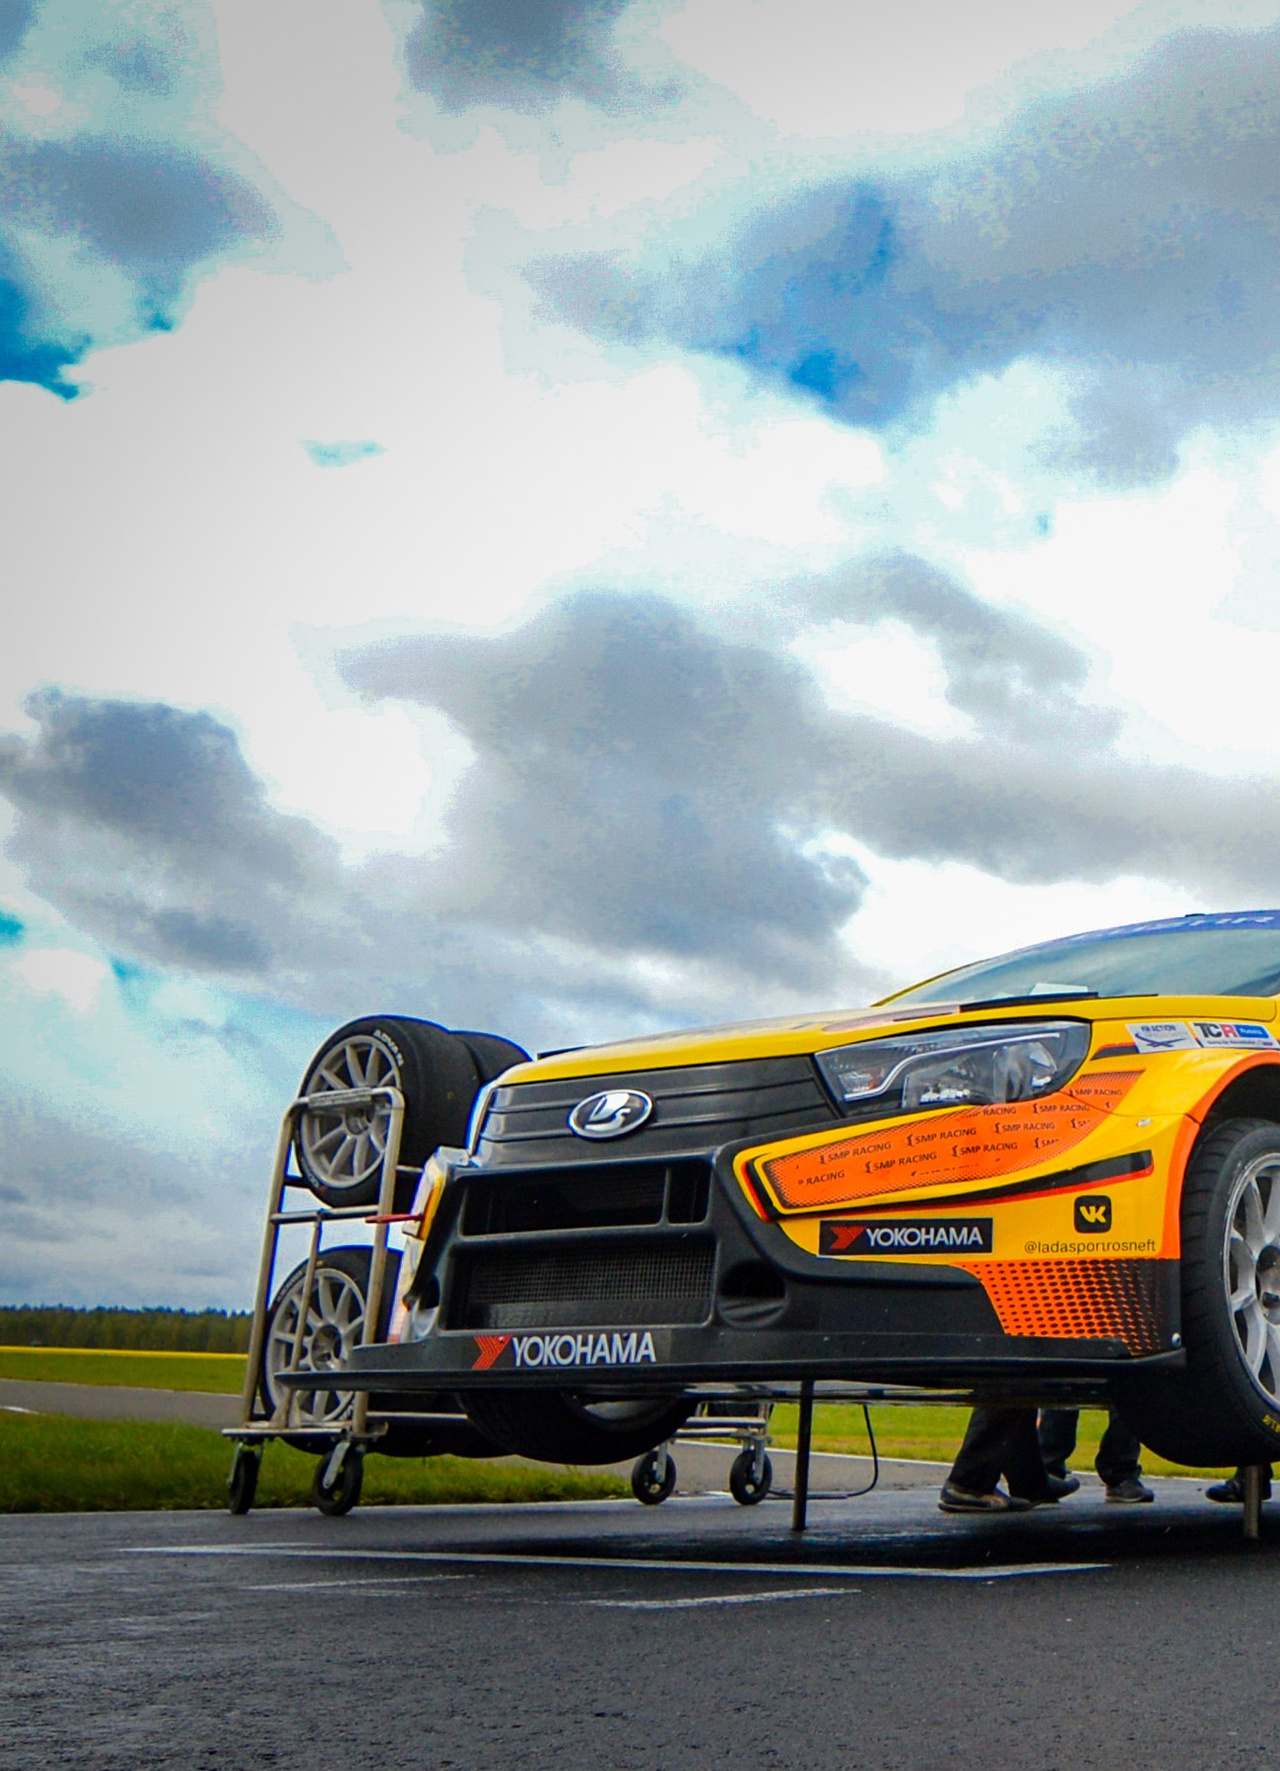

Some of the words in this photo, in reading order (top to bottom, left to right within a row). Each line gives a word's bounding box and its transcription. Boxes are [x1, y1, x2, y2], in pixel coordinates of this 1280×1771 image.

[1194, 1023, 1239, 1038] TCR
[983, 1106, 1017, 1117] RACING
[1039, 1104, 1059, 1113] SMP
[1060, 1101, 1091, 1112] RACING
[828, 1149, 850, 1162] SMP
[853, 1141, 892, 1156] RACING
[914, 1133, 937, 1144] SMP
[939, 1127, 977, 1140] RACING
[1001, 1123, 1021, 1133] SMP
[1023, 1121, 1056, 1131] RACING
[806, 1170, 846, 1186] RACING
[873, 1159, 896, 1171] SMP
[899, 1151, 937, 1166] RACING
[960, 1145, 981, 1156] SMP
[982, 1142, 1018, 1153] RACING
[866, 1226, 983, 1247] YOKOHAMA
[512, 1332, 657, 1367] YOKOHAMA
